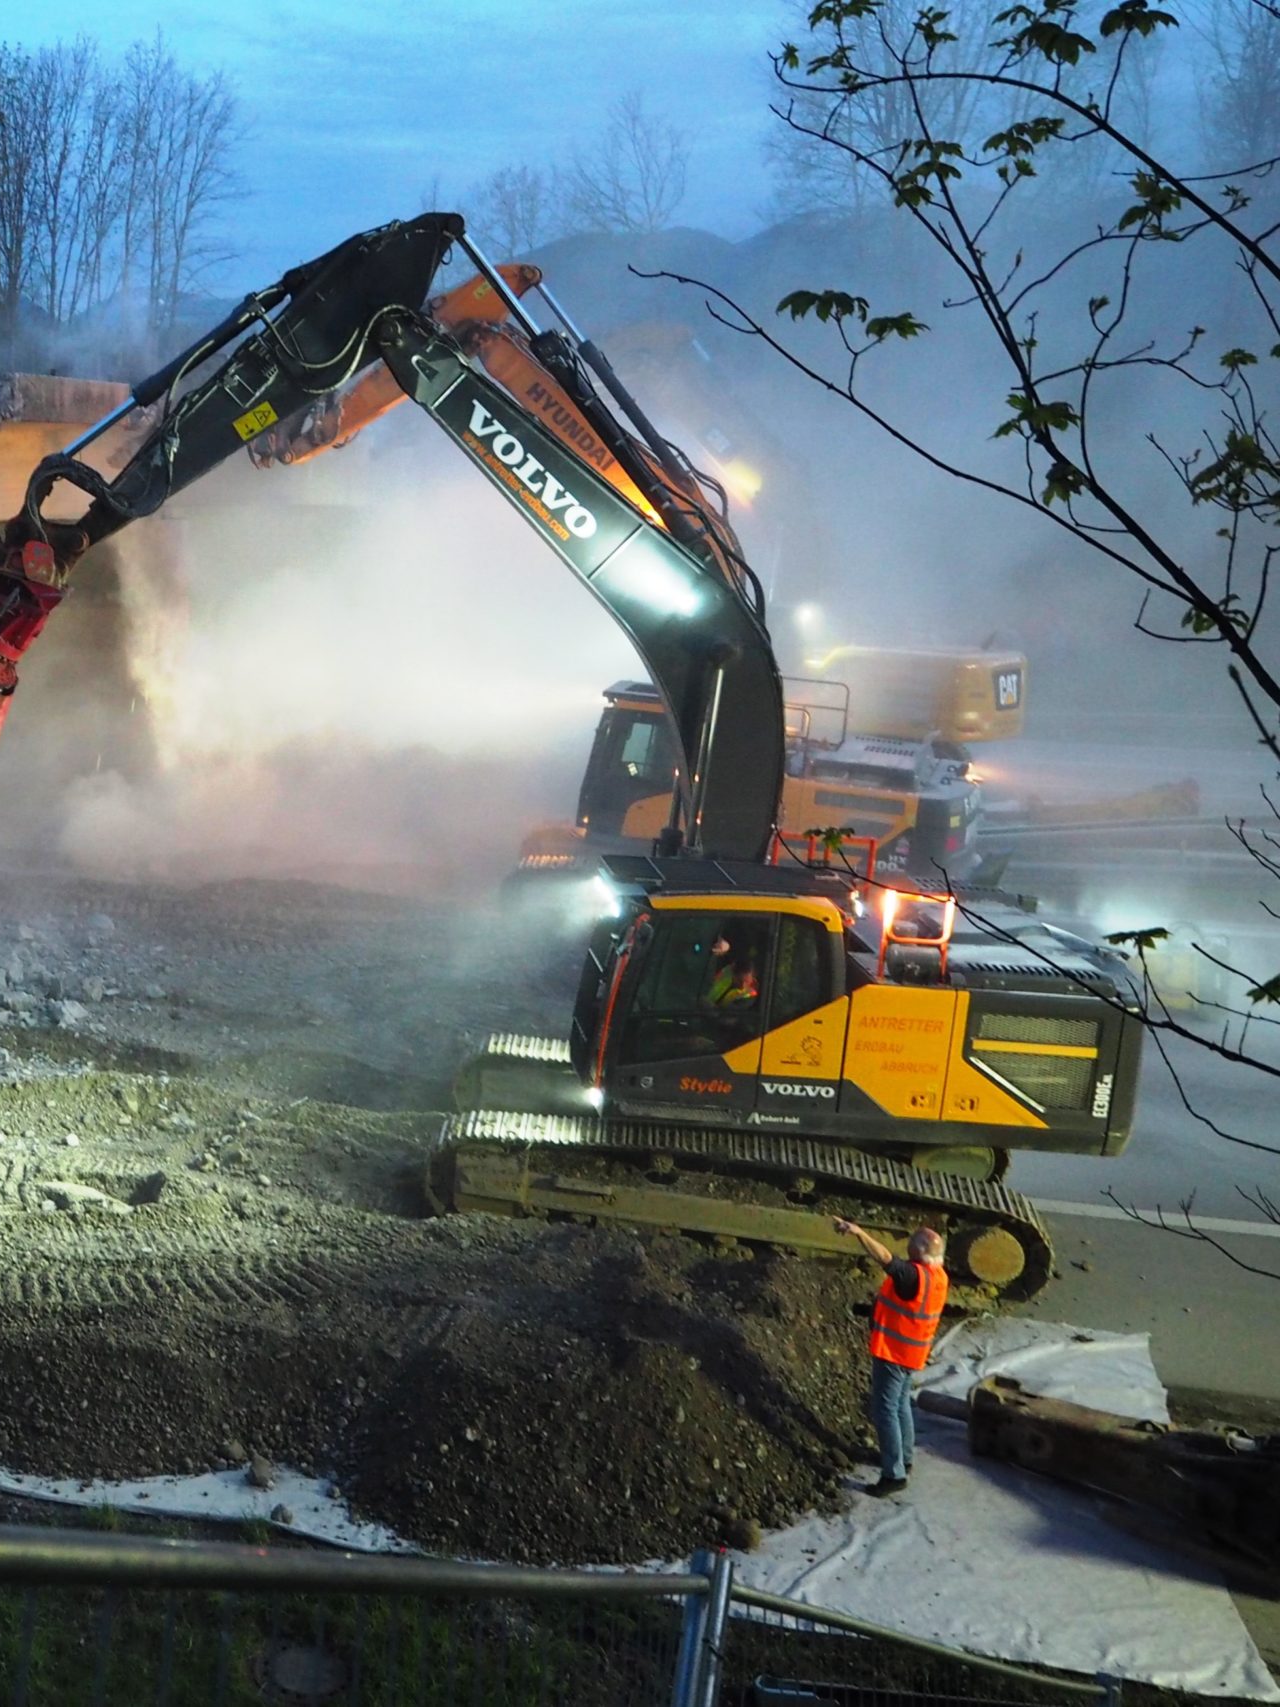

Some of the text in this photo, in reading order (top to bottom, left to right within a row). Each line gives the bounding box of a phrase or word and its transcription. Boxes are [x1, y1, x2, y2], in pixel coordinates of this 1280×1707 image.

[526, 382, 616, 471] HYUNDAI
[469, 399, 597, 538] VOLVO
[999, 673, 1018, 706] CAT
[858, 1015, 944, 1033] ANTRETTER
[854, 1040, 904, 1054] ERDBAU
[880, 1060, 939, 1074] ABBRUCH
[761, 1082, 835, 1098] VOLVO
